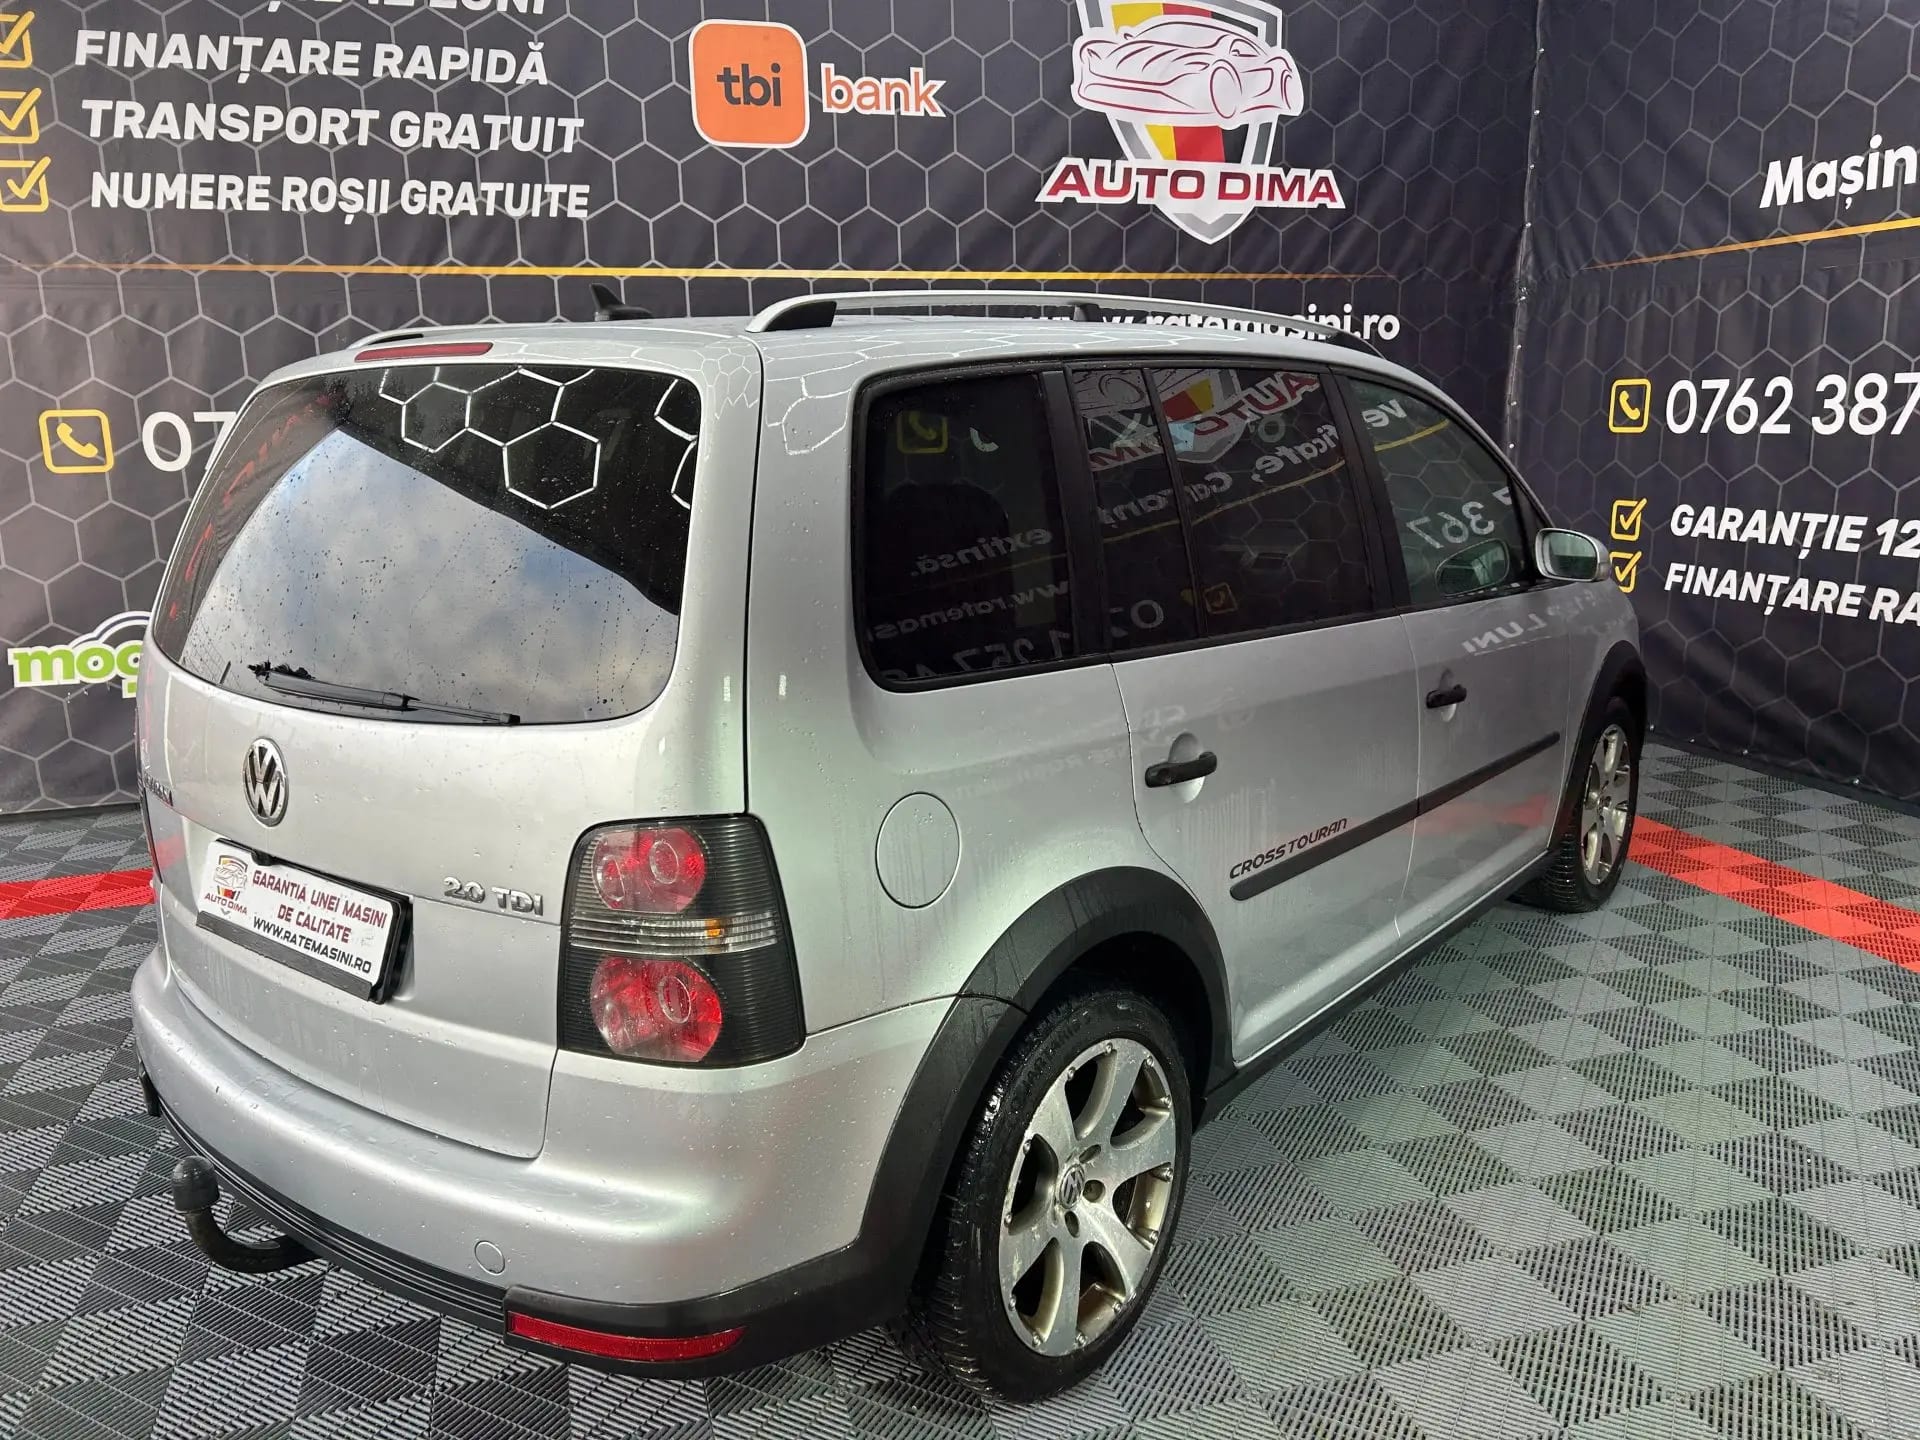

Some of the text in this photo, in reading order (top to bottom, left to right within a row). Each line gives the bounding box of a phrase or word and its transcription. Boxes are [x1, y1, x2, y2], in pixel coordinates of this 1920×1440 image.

[75, 29, 549, 86] FINANȚARE RAPIDĂ
[716, 64, 940, 117] tbi bank
[82, 99, 585, 154] TRANSPORT GRATUIT
[91, 171, 590, 225] NUMERE ROȘII GRATUITE
[1046, 164, 1338, 204] AUTO DIMA
[1666, 372, 1920, 436] 0762 387
[1670, 504, 1920, 560] GARANȚIE 12
[1665, 562, 1920, 627] FINANȚARE RA
[204, 891, 249, 916] AUTO DIMA
[251, 870, 389, 929] GARANTIA UNEI MASINI
[276, 904, 353, 944] DE CALITATE
[490, 886, 544, 916] TDI
[252, 915, 373, 975] WWW.RATEMASINI.RO
